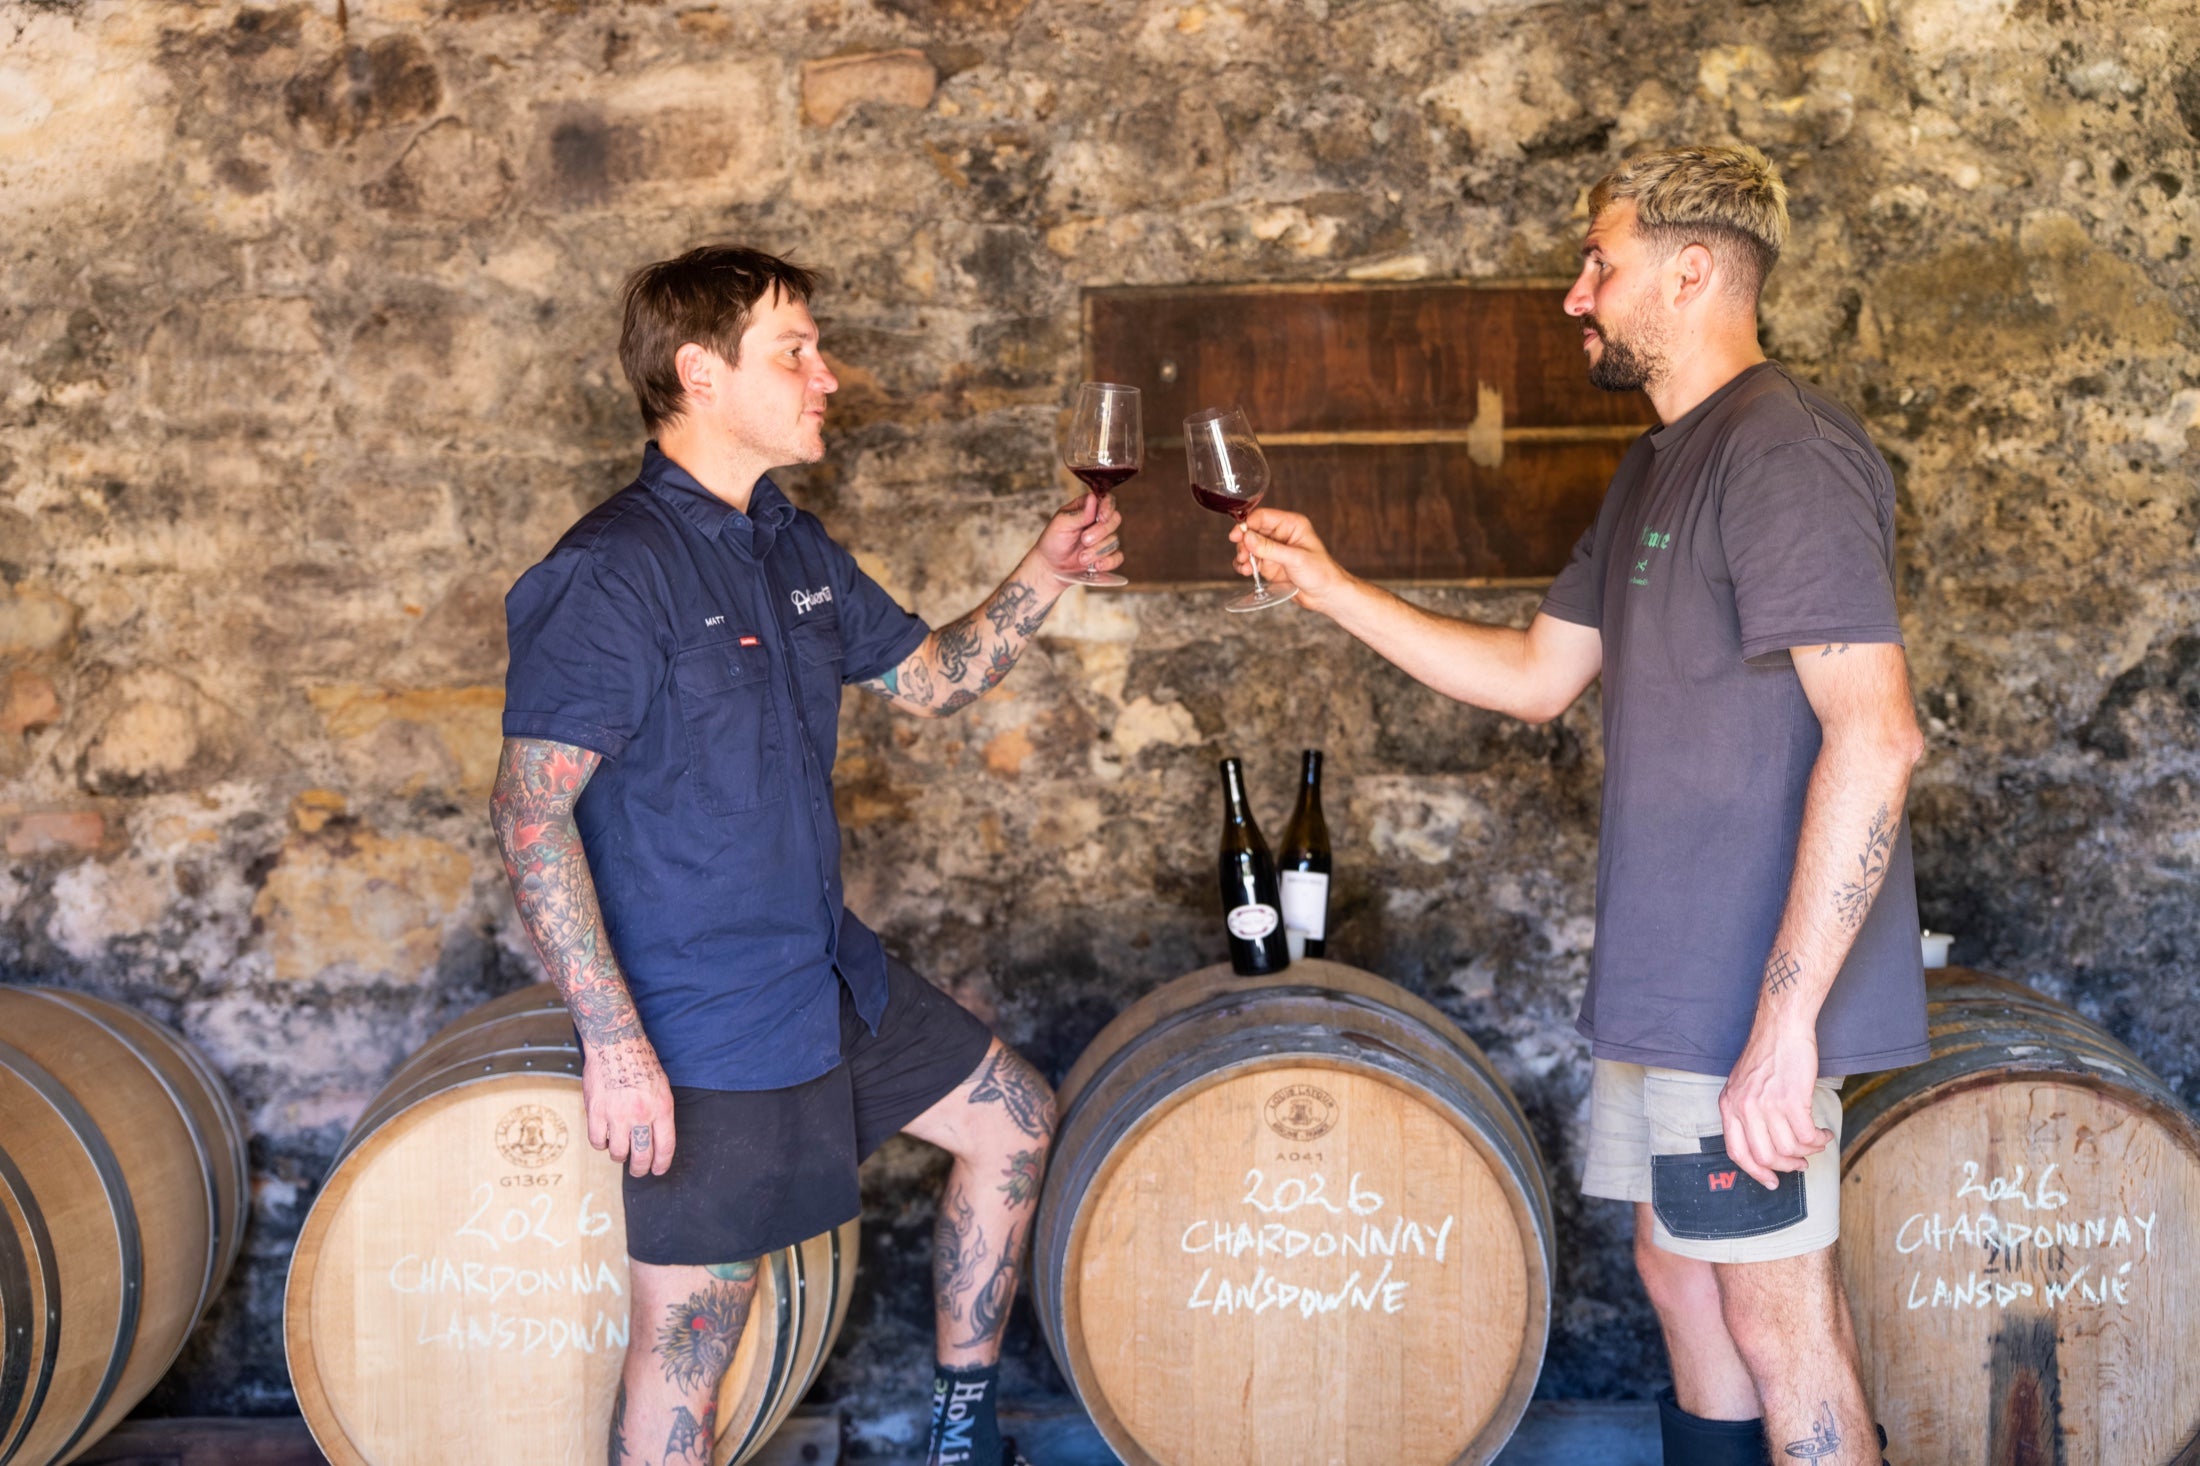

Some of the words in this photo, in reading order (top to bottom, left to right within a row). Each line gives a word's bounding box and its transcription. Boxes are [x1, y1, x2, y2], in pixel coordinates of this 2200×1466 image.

[704, 615, 726, 627] MATT
[500, 1173, 563, 1188] G1367
[1275, 1151, 1323, 1163] A041
[1708, 1171, 1738, 1191] HY
[1242, 1168, 1385, 1216] 2026
[1957, 1160, 2068, 1211] 2026
[455, 1182, 612, 1251] 2026
[1181, 1214, 1454, 1263] CHARDONNAY
[1896, 1211, 2157, 1255] CHARDONNAY
[389, 1253, 630, 1303] CHARDONNA
[1187, 1259, 1409, 1319] LANSDOWNE
[1907, 1262, 2132, 1309] LANSDOWNE
[418, 1303, 631, 1358] LANSDOWN
